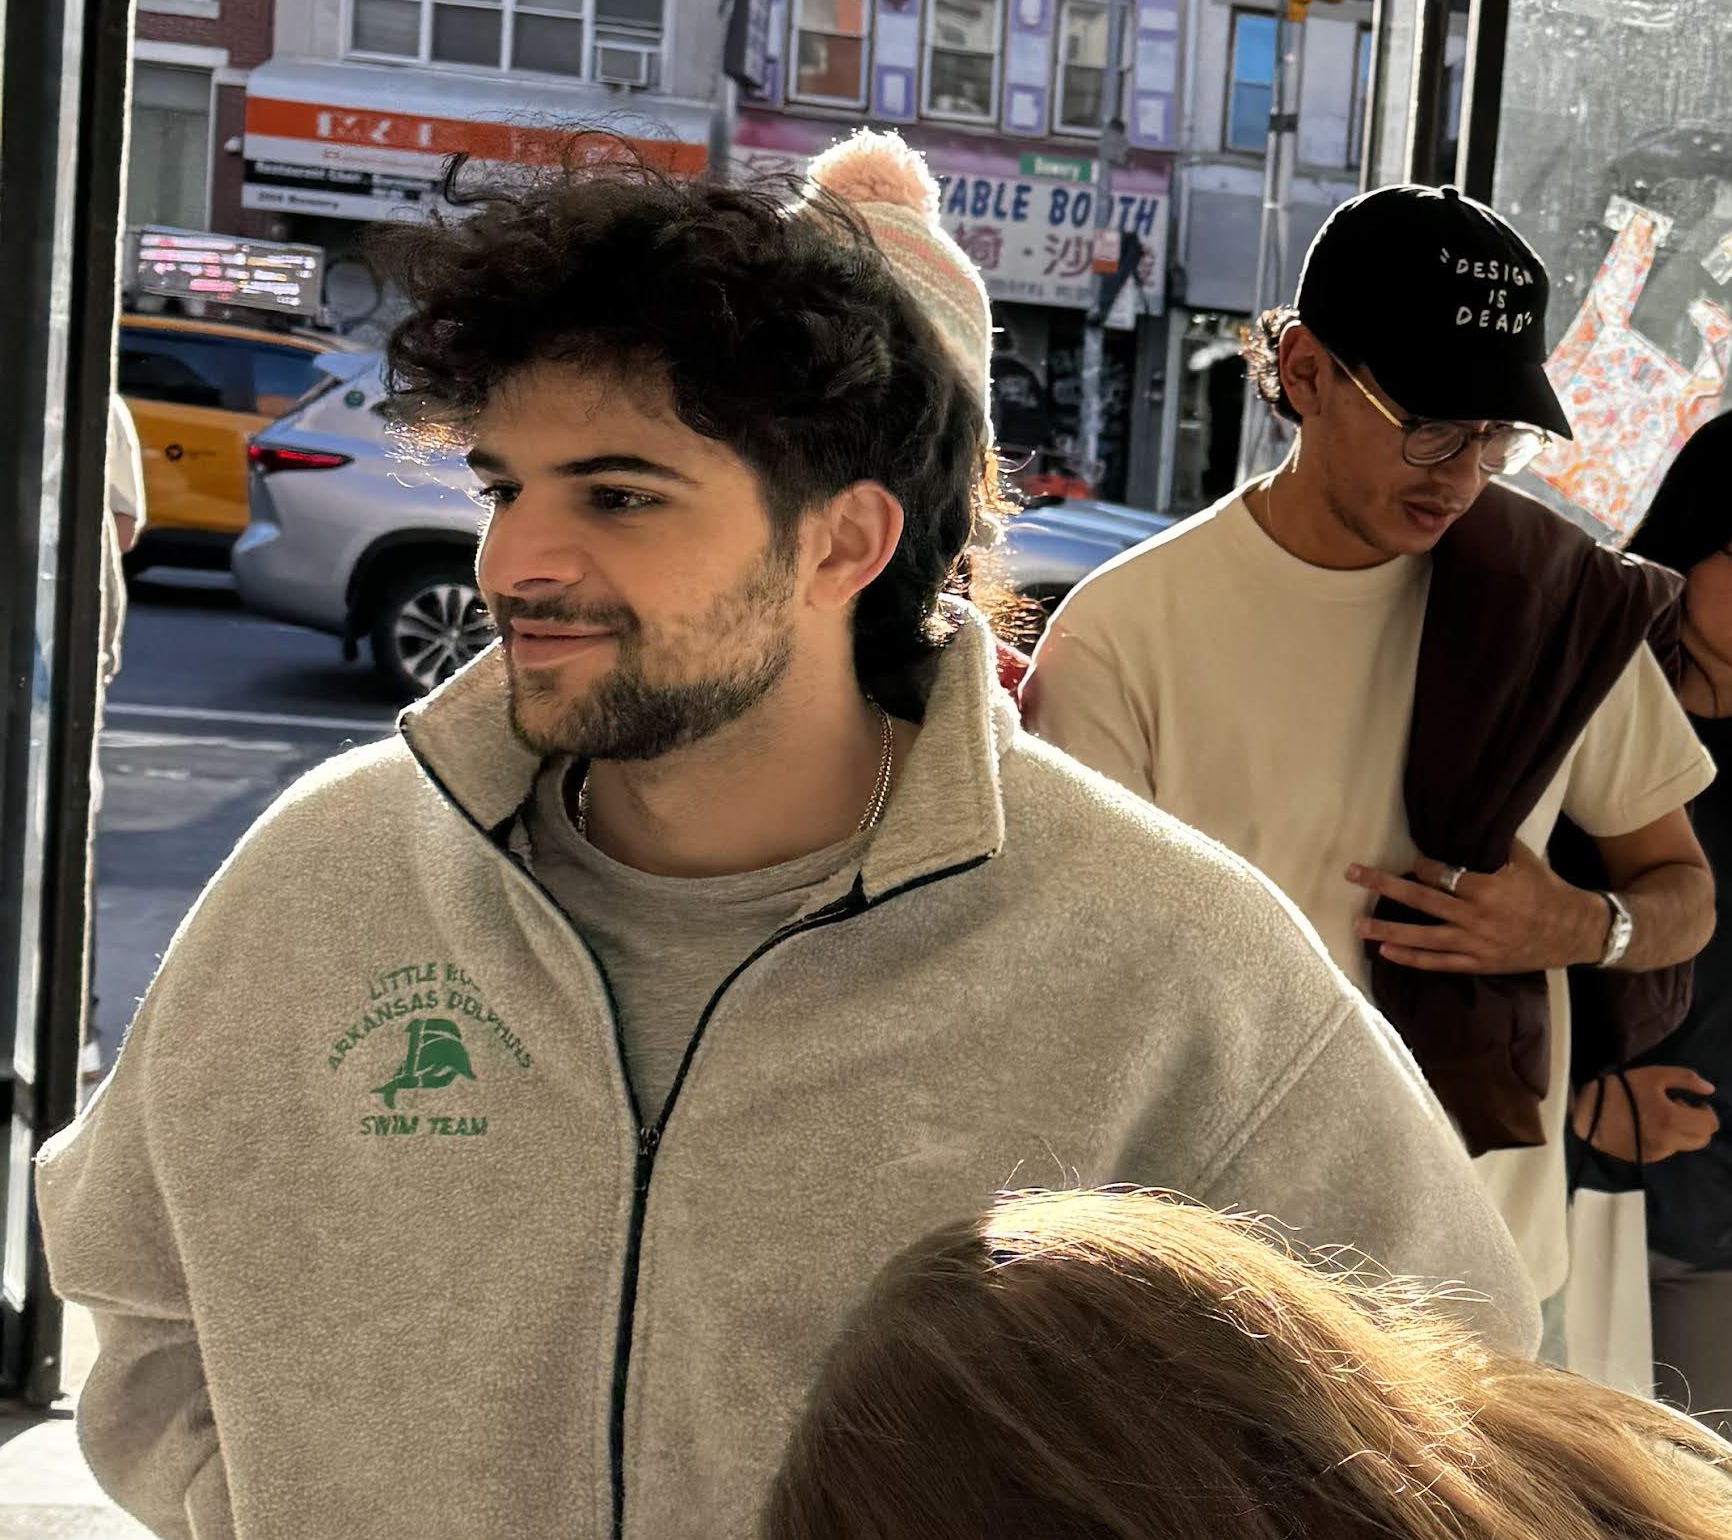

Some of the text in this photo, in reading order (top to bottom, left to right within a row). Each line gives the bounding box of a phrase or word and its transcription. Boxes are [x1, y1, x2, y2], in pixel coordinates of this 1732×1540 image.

[1048, 187, 1159, 237] BOTH
[1489, 289, 1507, 309] IS
[368, 962, 437, 1000] LITTLE
[328, 990, 535, 1070] ARKANSAS DOLPHINS
[360, 1116, 488, 1146] SWIM TEAM
